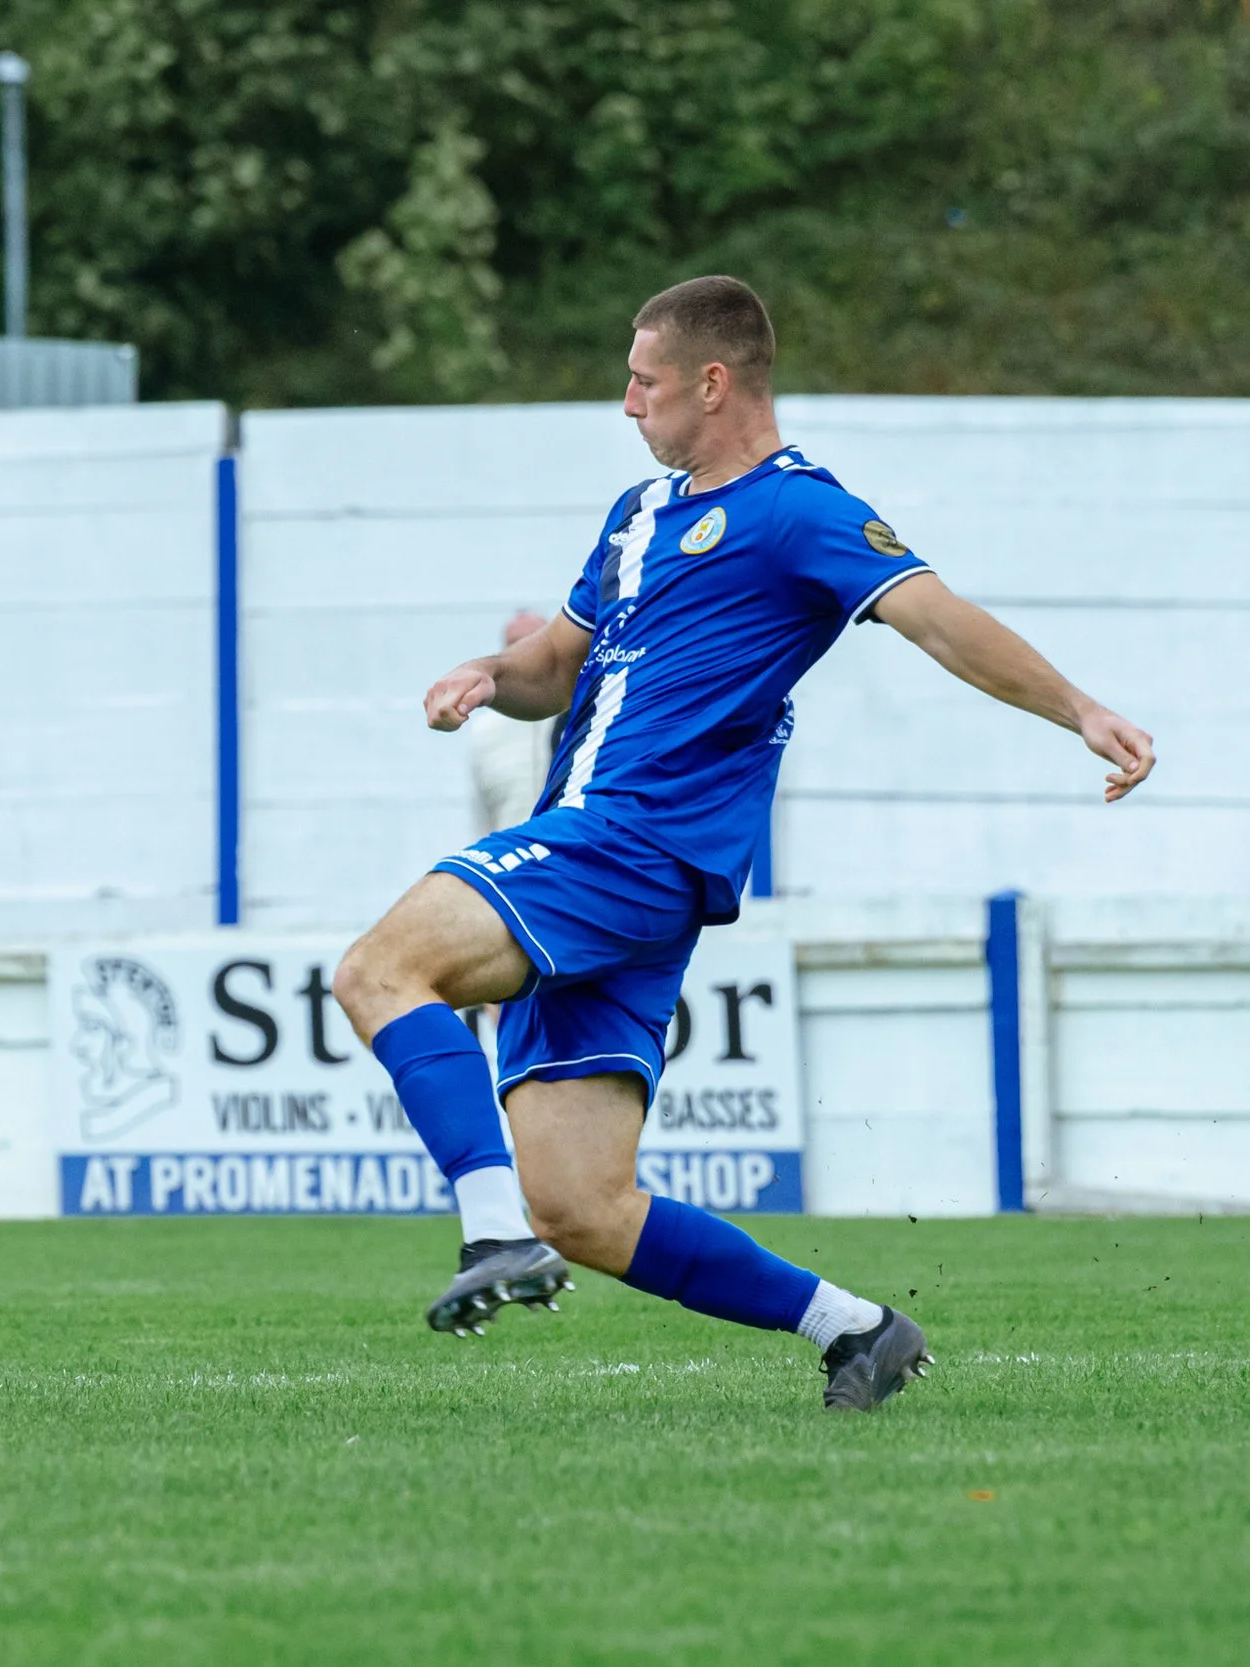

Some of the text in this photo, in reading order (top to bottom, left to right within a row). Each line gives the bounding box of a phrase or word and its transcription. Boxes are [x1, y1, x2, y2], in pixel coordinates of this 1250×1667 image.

[211, 1091, 331, 1133] VIOLINS
[659, 1089, 779, 1132] BASSES
[80, 1152, 775, 1212] AT PROMENADE SHOP
